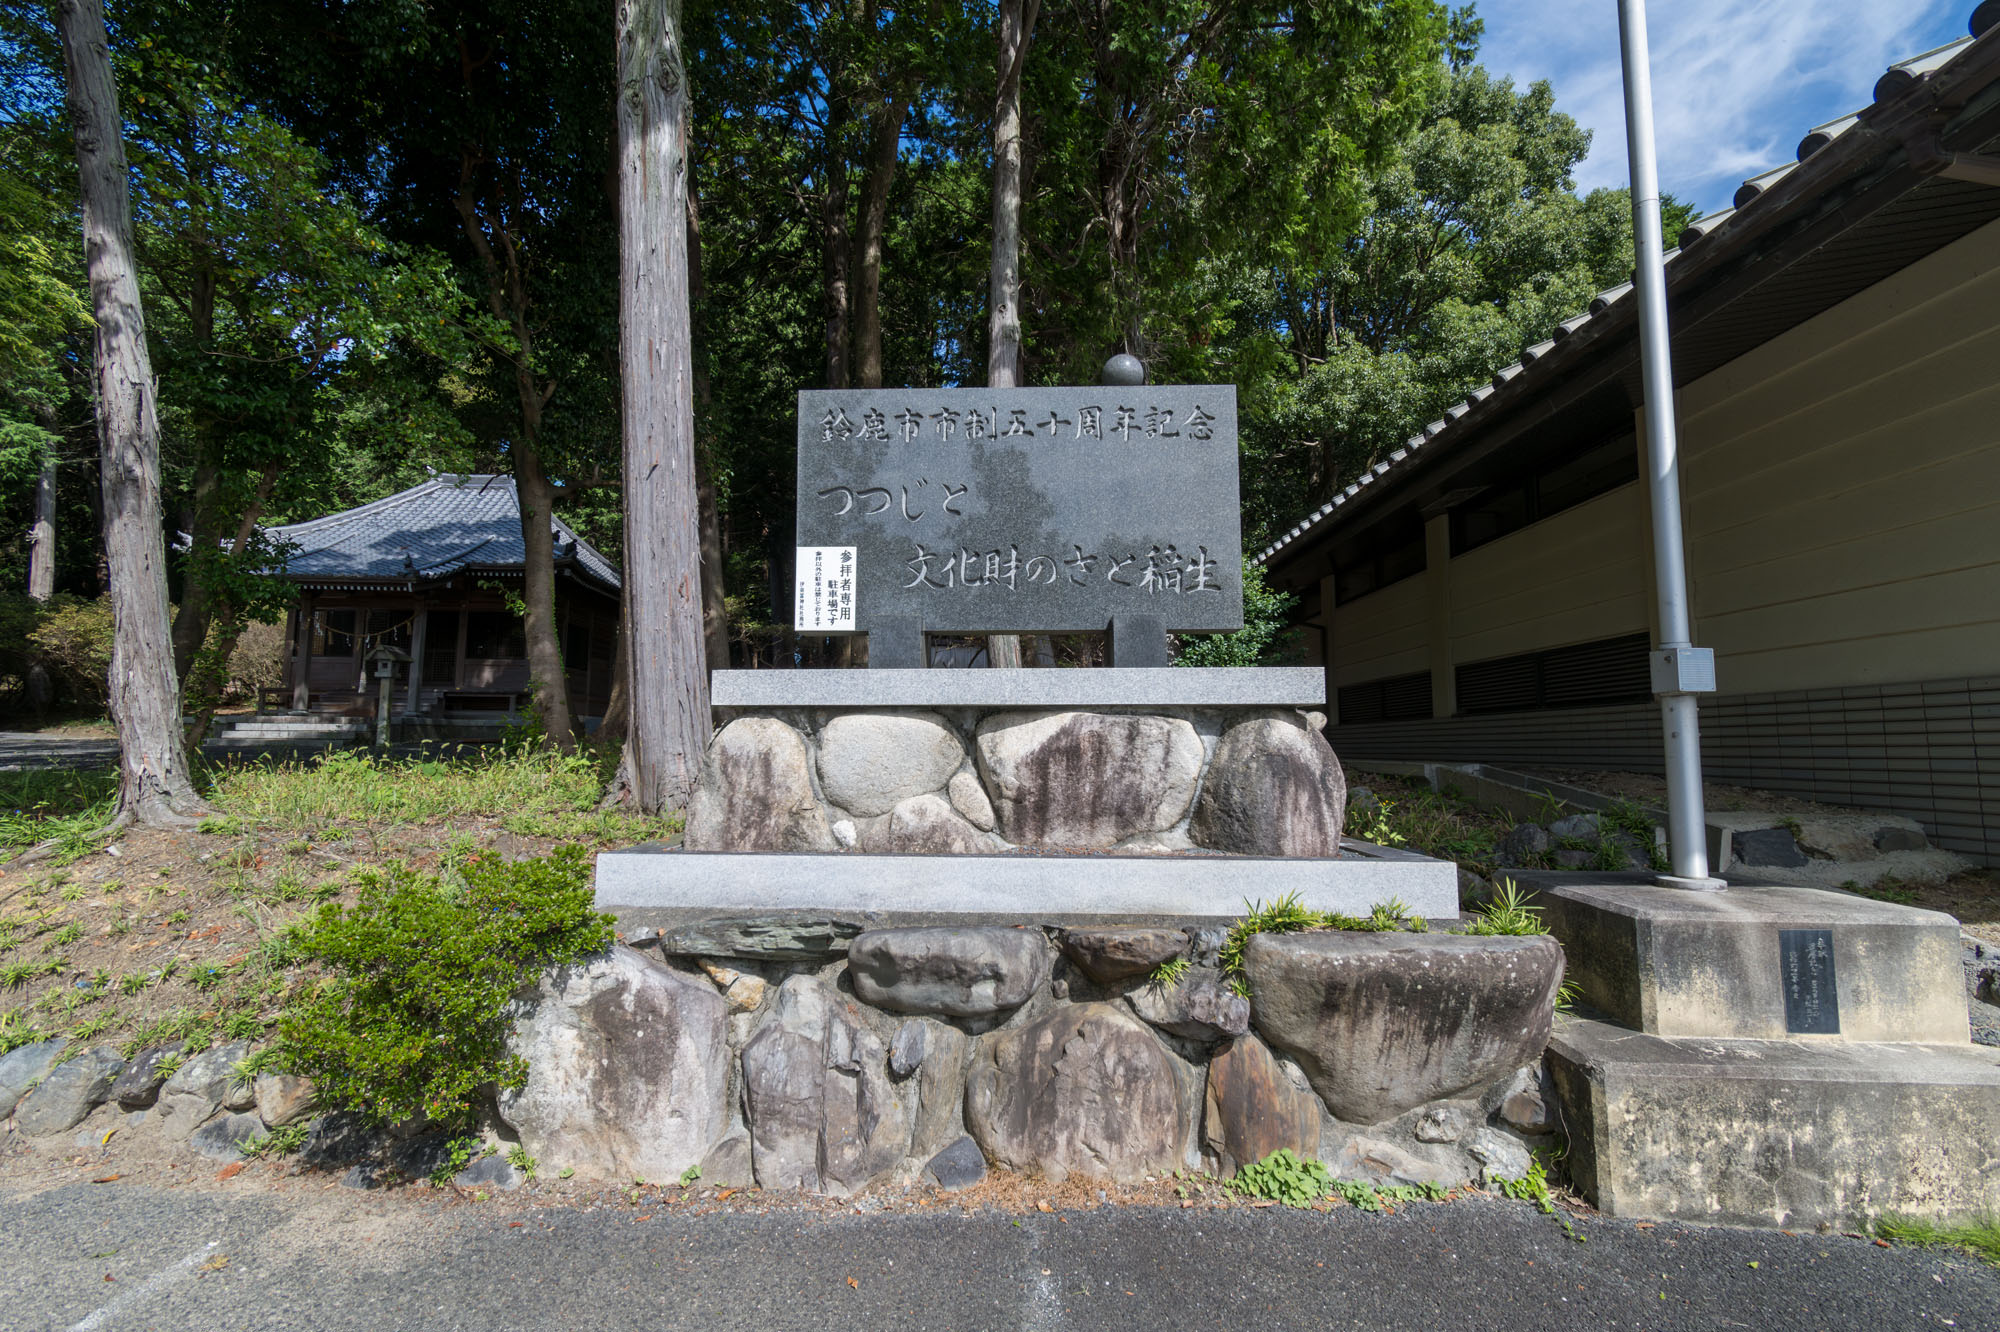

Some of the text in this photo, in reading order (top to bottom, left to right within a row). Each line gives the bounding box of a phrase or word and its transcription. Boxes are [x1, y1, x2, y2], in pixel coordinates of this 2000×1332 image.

[819, 405, 1216, 443] 鈴鹿市市制五十周年記念
[817, 477, 968, 523] つつじと
[840, 549, 852, 621] 参拝者専用
[903, 543, 1222, 596] 文化財のさと稲生
[827, 580, 838, 626] 駐車場です
